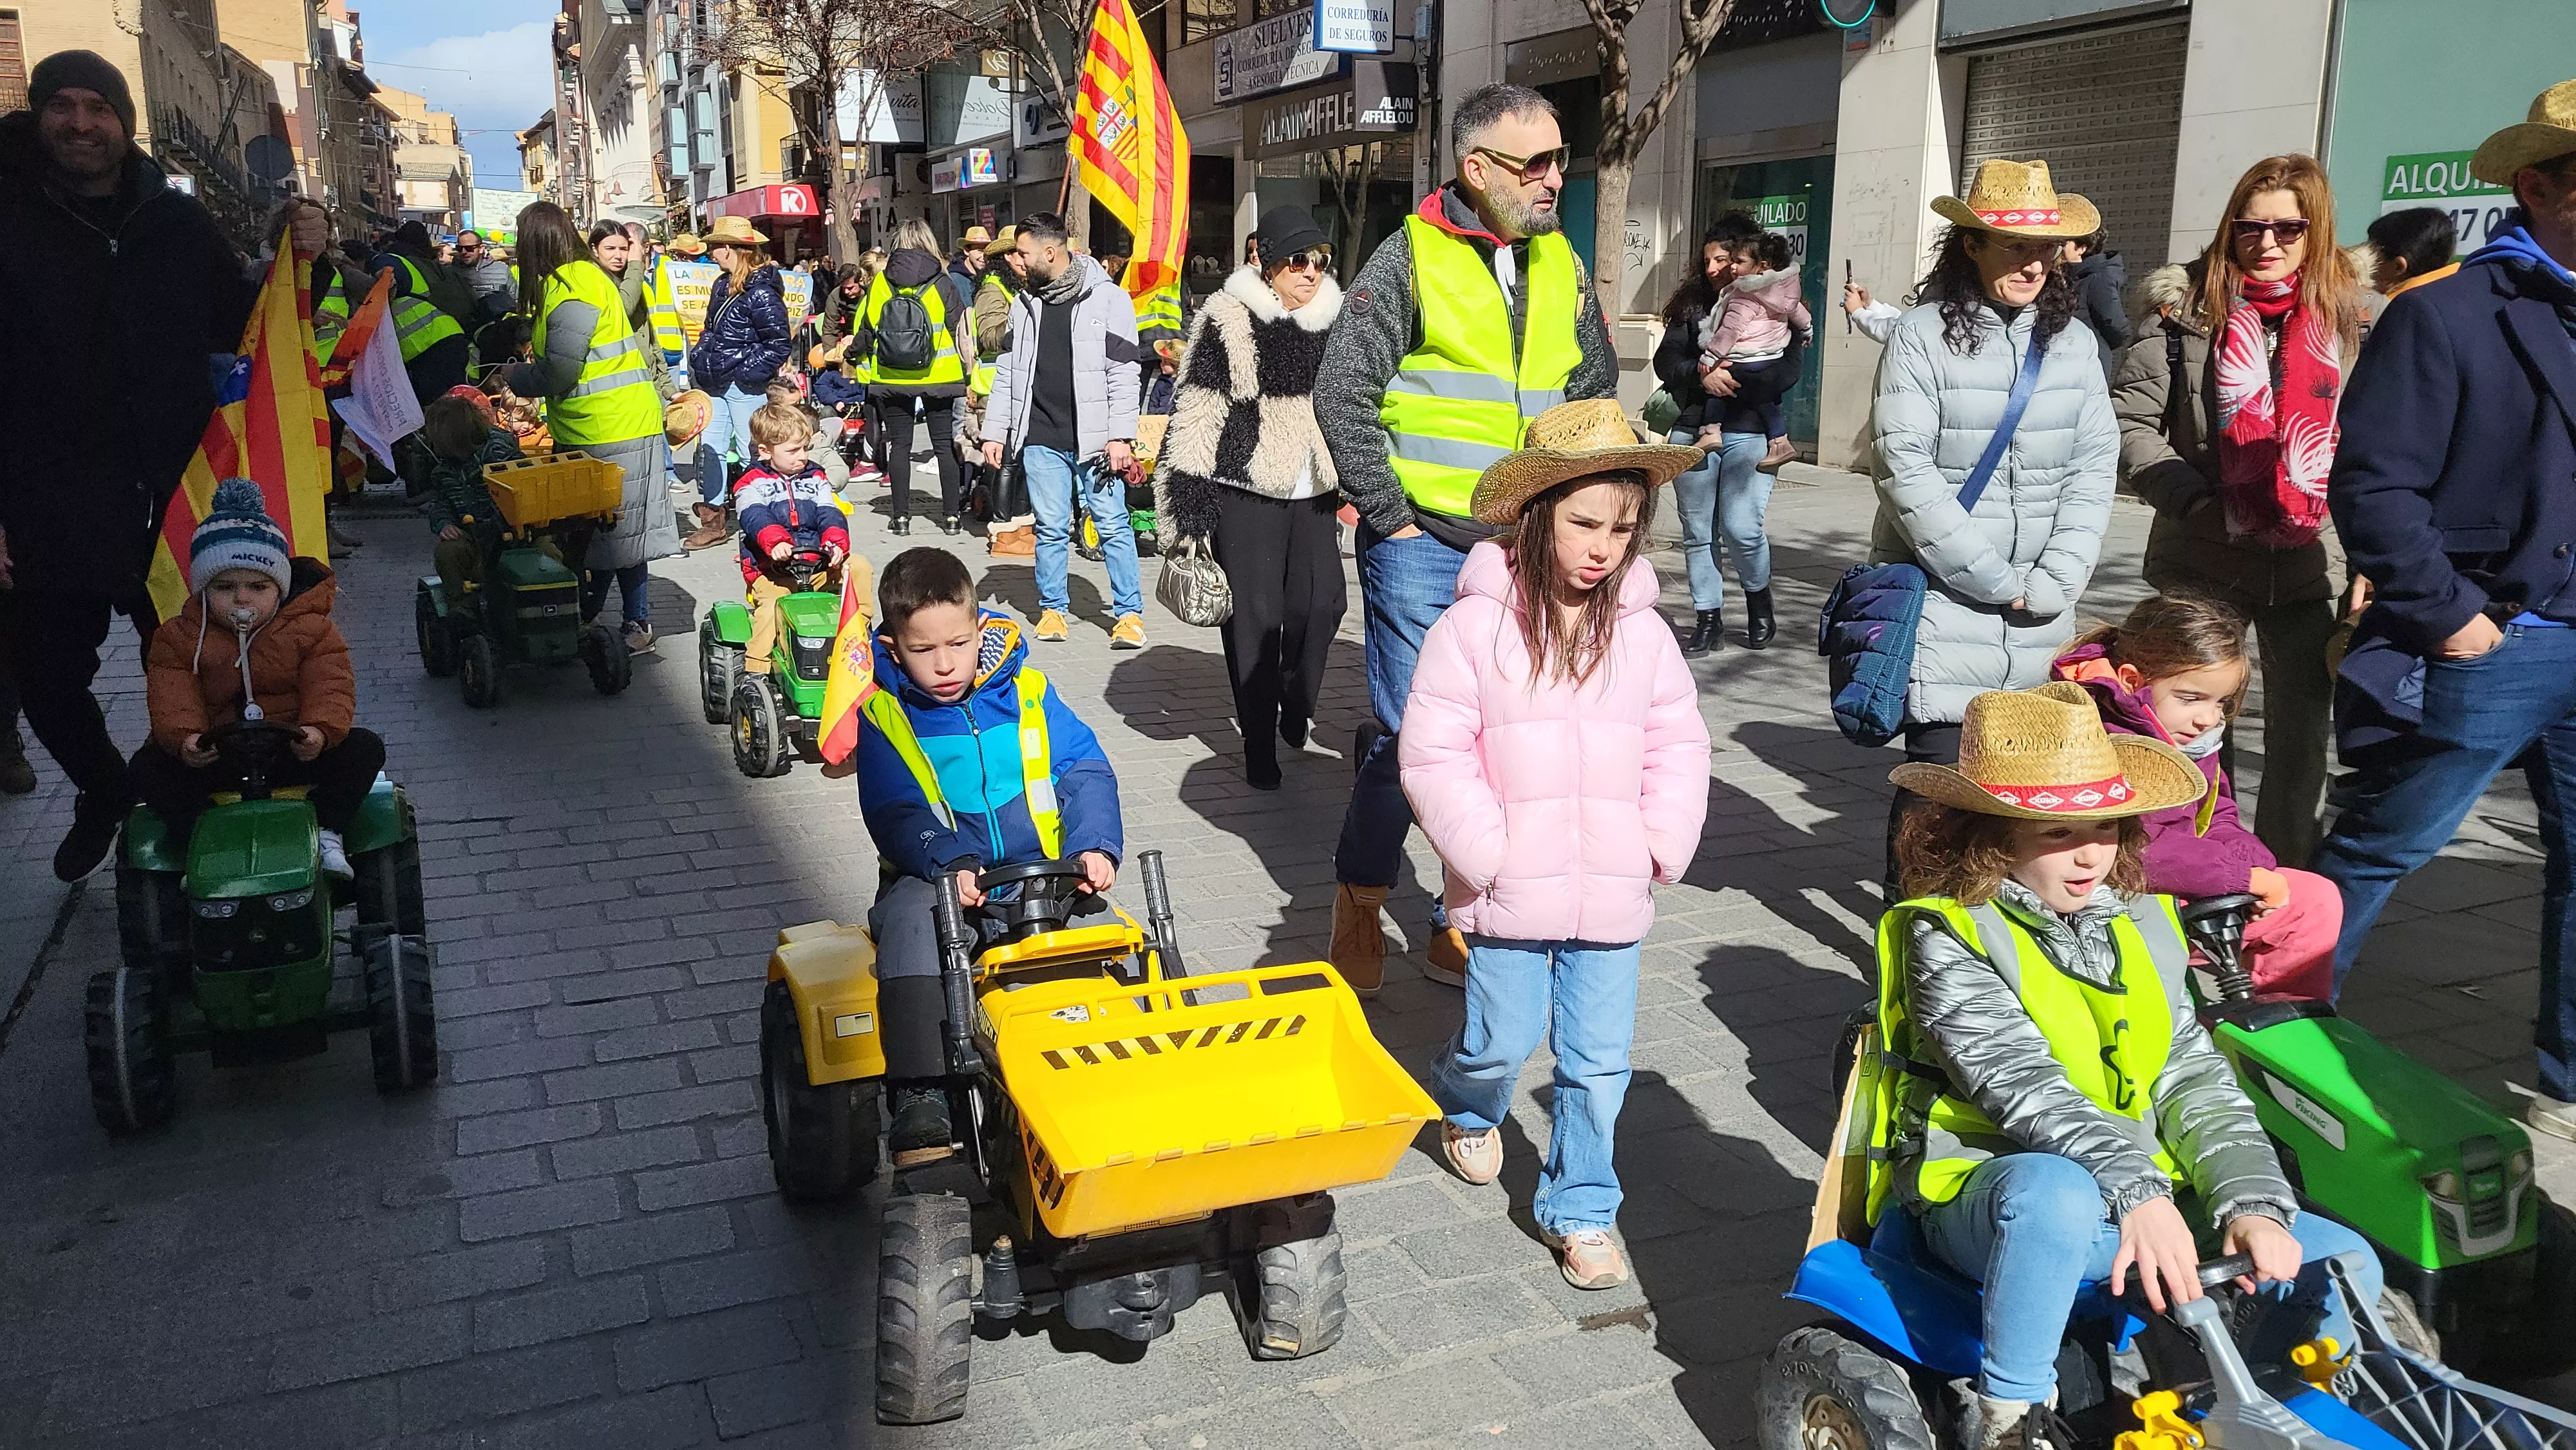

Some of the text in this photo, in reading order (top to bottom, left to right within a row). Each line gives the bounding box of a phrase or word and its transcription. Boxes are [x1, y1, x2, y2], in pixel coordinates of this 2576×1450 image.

[1327, 6, 1389, 23] CORREDURÍA
[1255, 10, 1312, 50] SUELVES
[1329, 27, 1387, 42] DE SEGUROS
[1237, 46, 1283, 73] CORREDURÍA
[1285, 45, 1295, 60] DE
[1248, 59, 1320, 90] ASESORÍA TÉCNICA
[1378, 96, 1414, 110] ALAIN
[1258, 91, 1353, 146] ALAIN AFFLE
[1359, 110, 1414, 124] AFFLELOU
[2388, 160, 2503, 196] ALQU
[1755, 201, 1806, 224] UILADO
[674, 267, 806, 288] LA AG RA
[677, 286, 805, 303] ES MU NDO
[682, 300, 696, 310] SE
[788, 307, 802, 317] PIZ
[231, 553, 276, 567] MICKEY
[2295, 1096, 2327, 1129] VIKING
